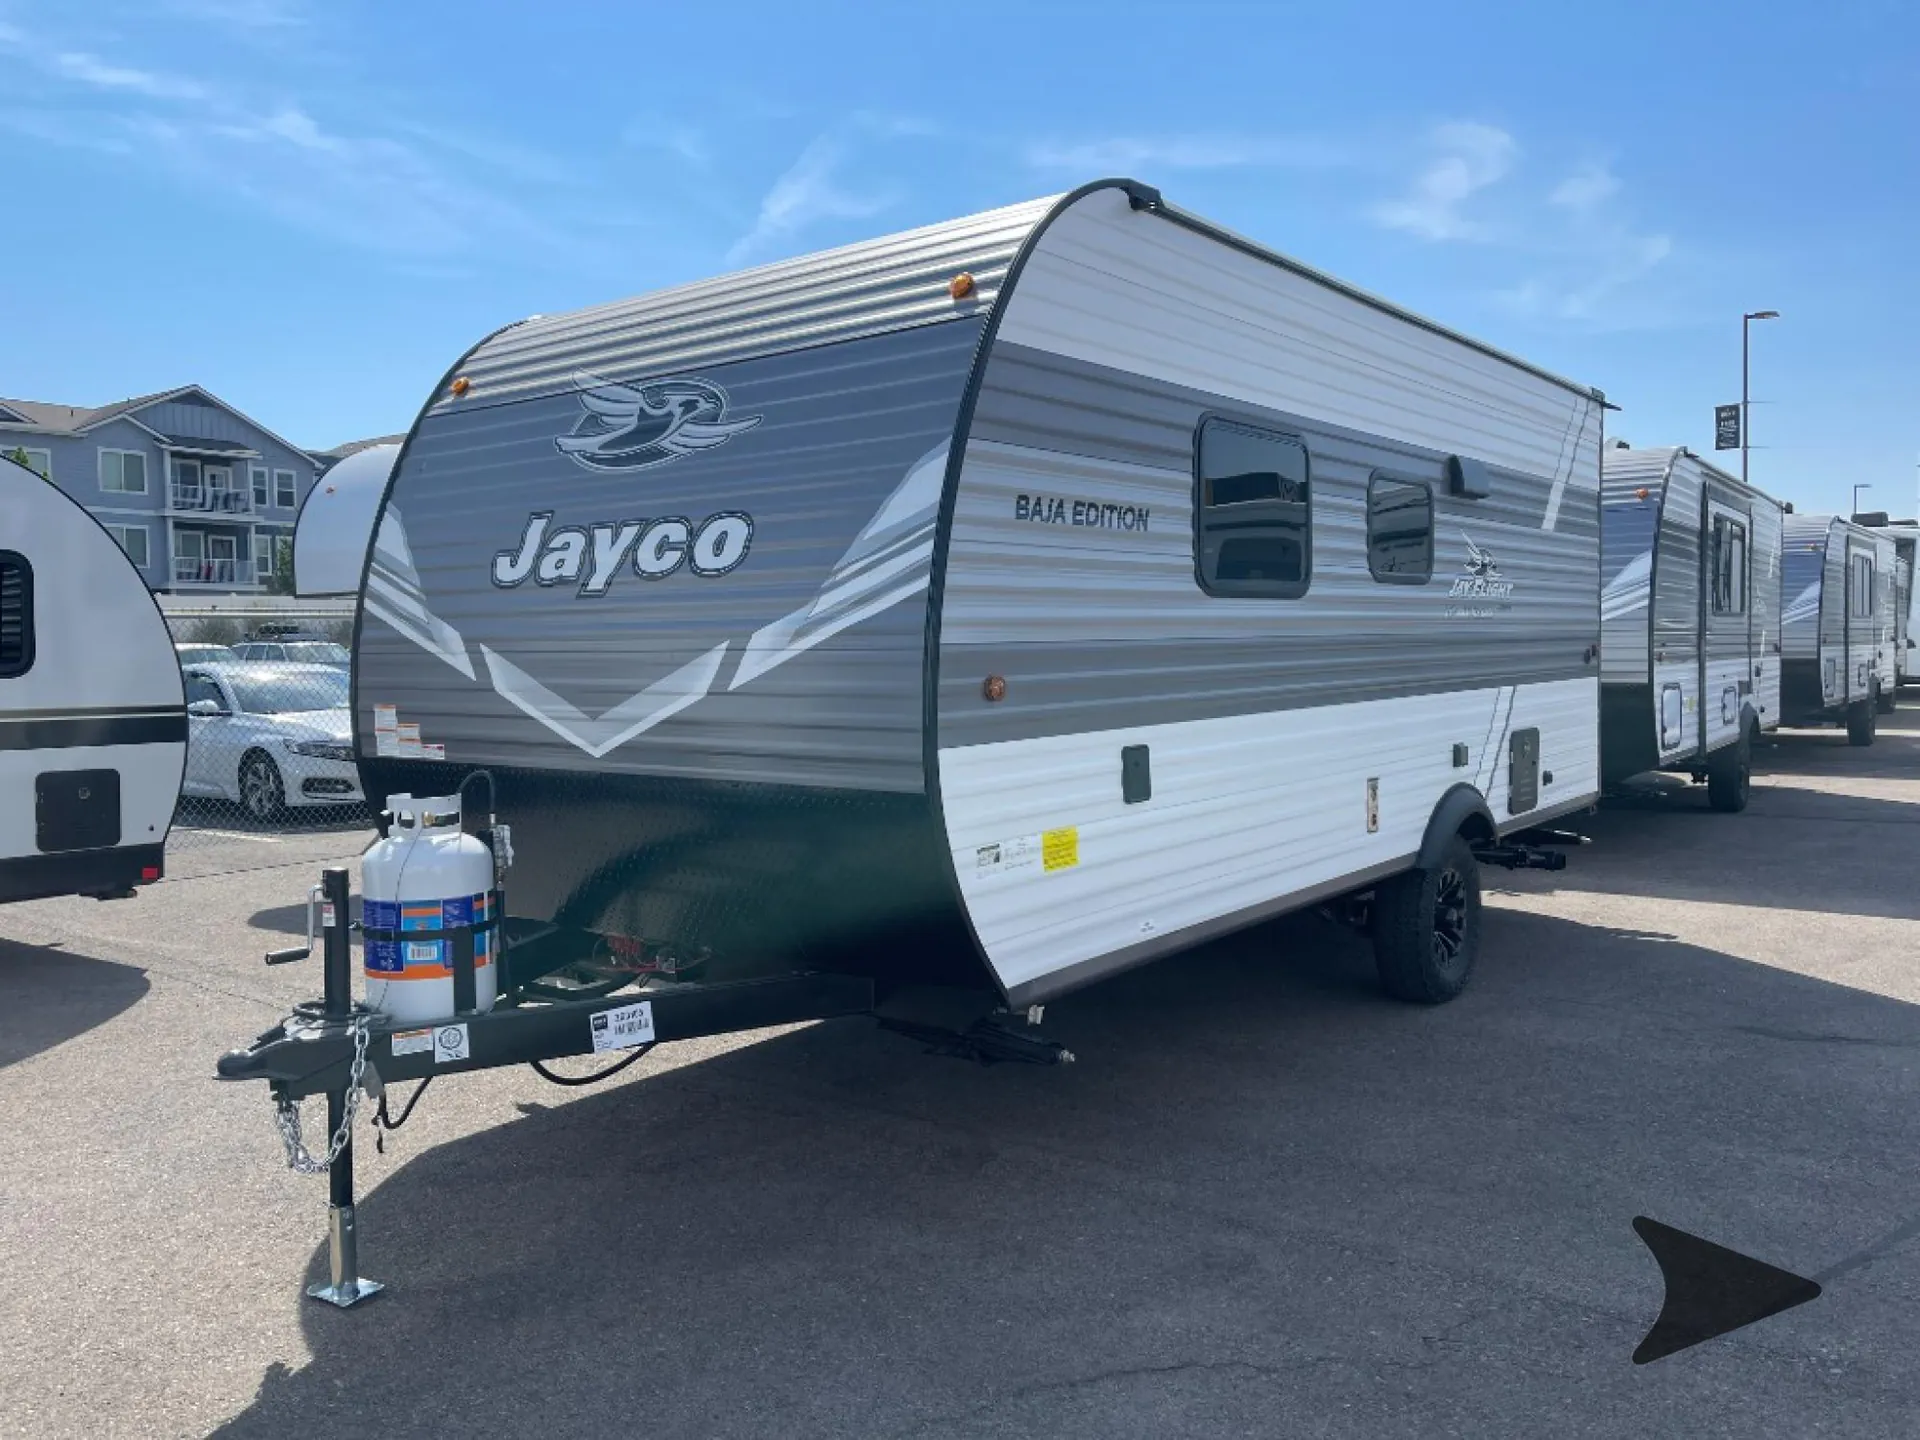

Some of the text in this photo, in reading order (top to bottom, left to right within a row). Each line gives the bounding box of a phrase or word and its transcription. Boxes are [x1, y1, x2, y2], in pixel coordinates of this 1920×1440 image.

[1016, 494, 1149, 532] BAJA EDITION
[491, 511, 754, 599] Jayco
